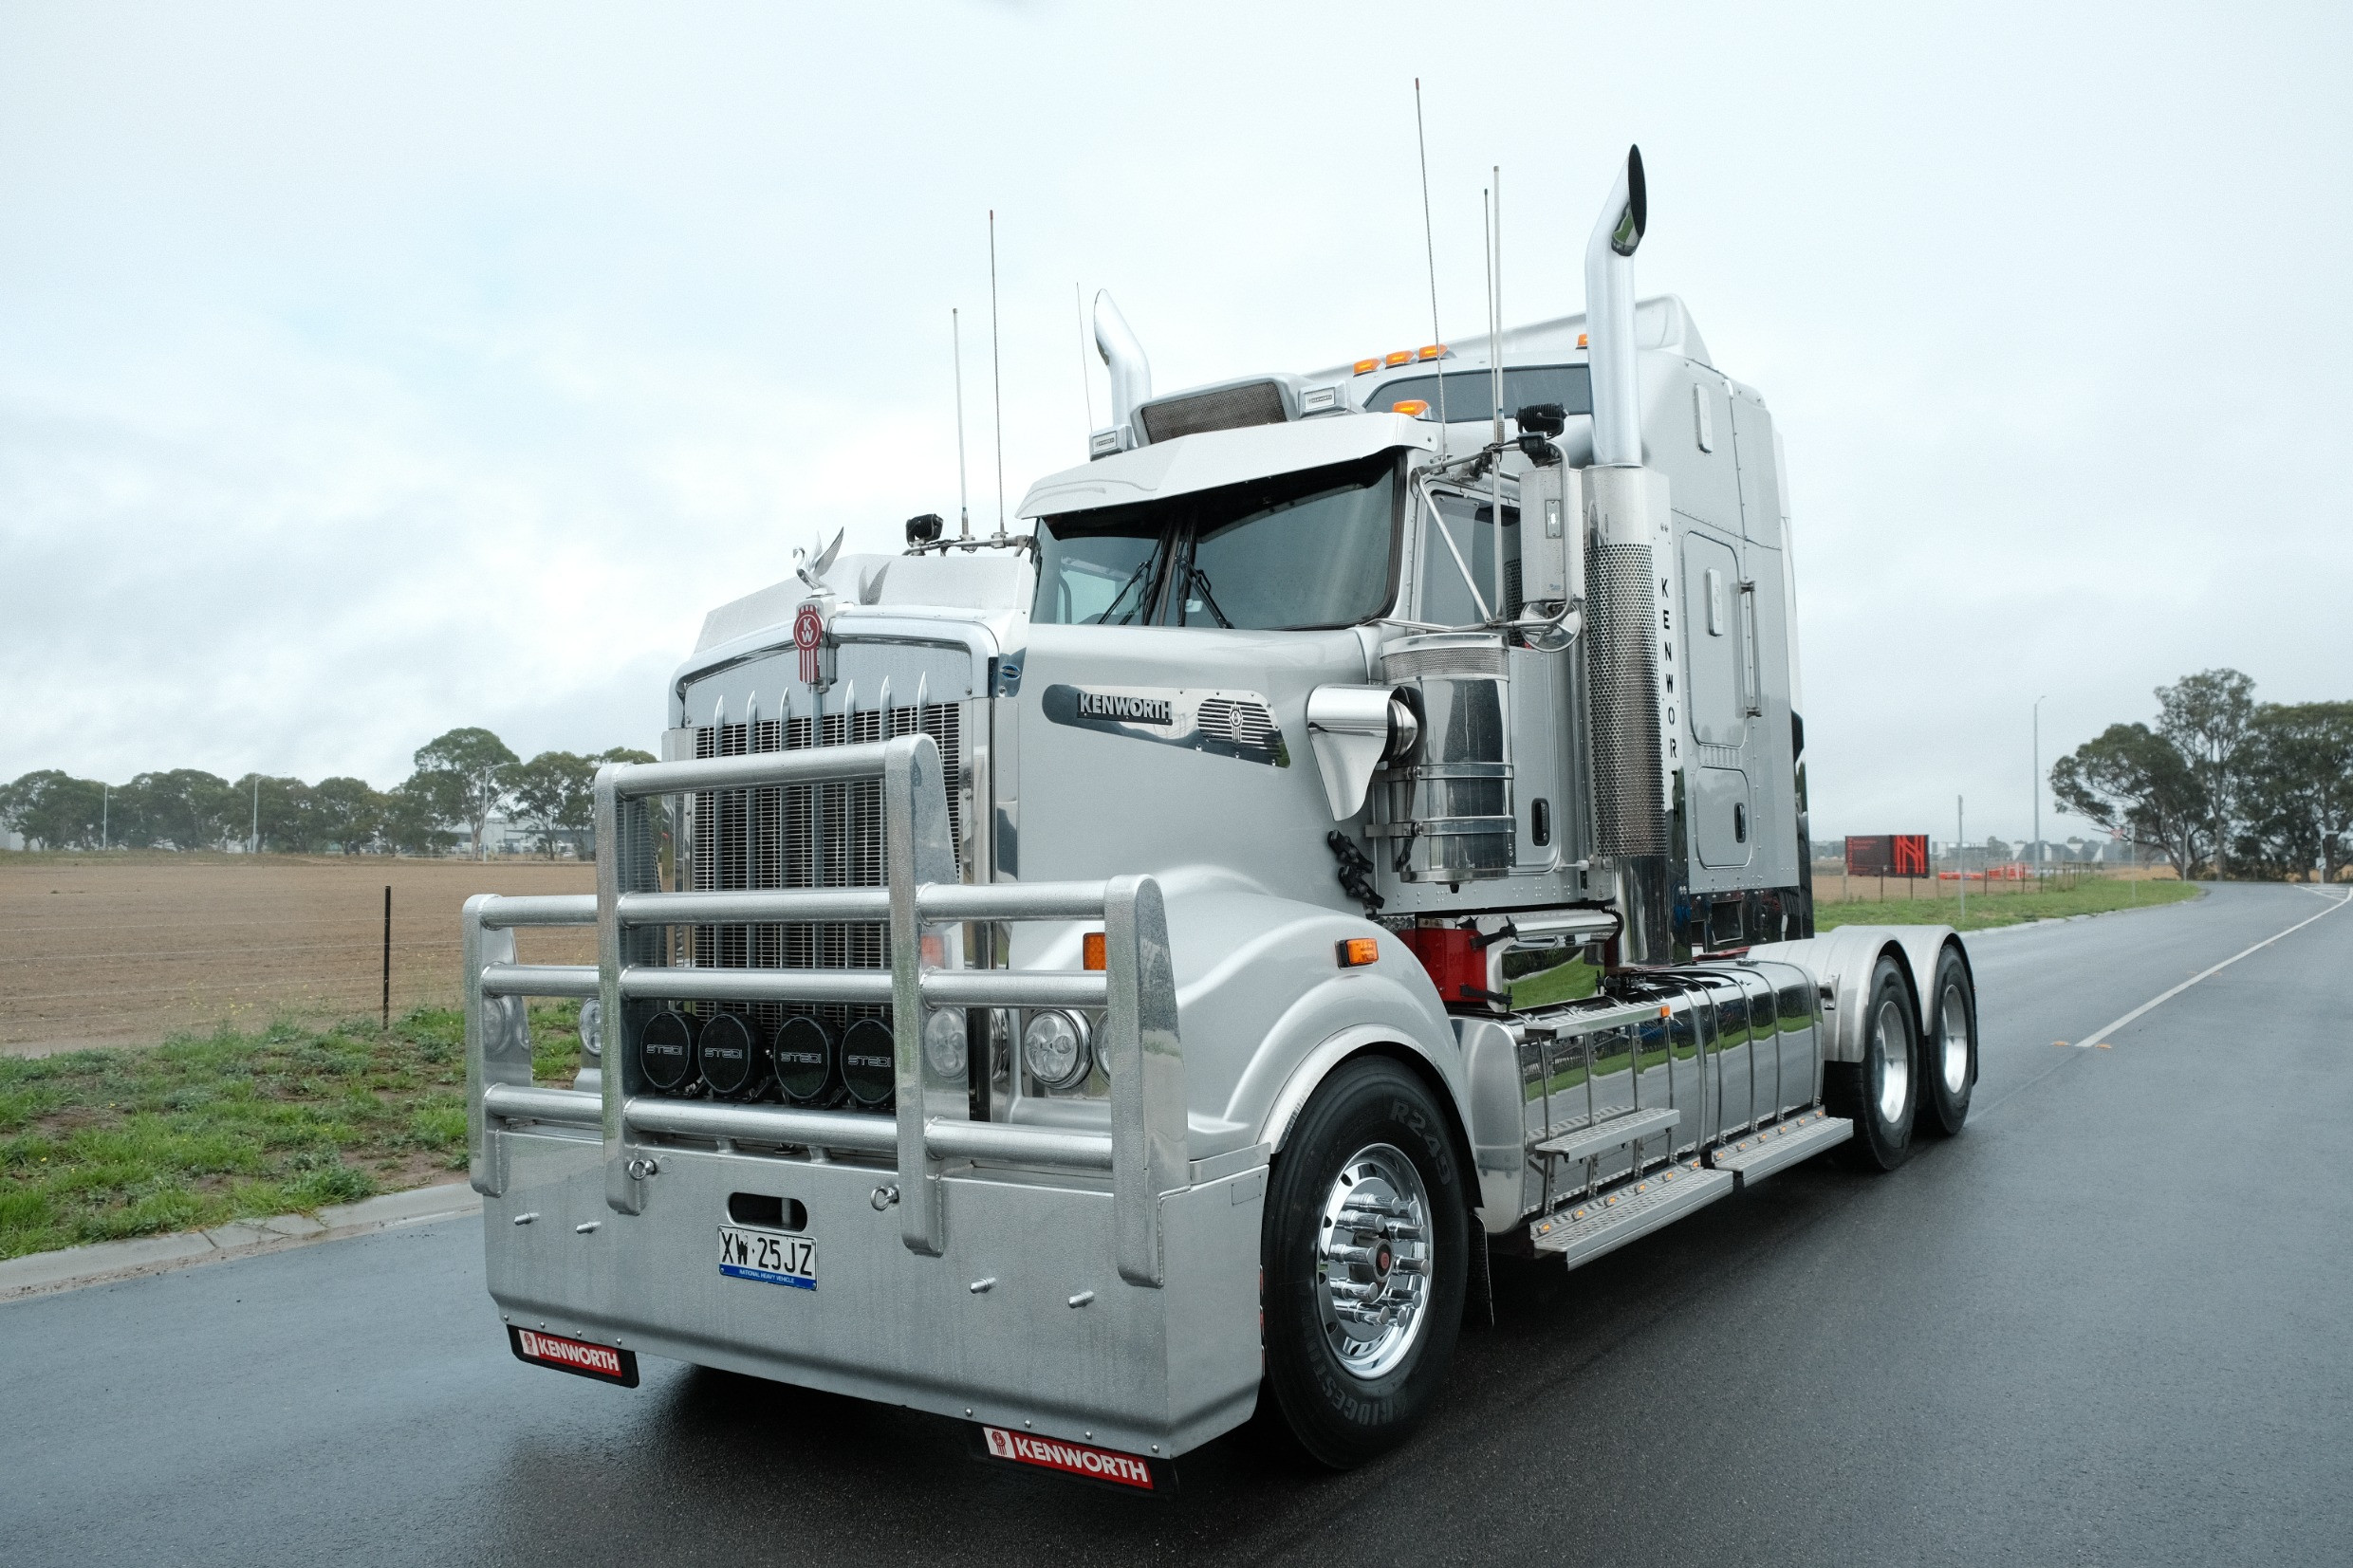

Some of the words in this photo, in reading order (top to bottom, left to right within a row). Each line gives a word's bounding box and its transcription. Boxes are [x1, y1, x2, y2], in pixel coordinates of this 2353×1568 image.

[1080, 693, 1173, 720] KENWORTH
[646, 1043, 683, 1056] STEDI
[704, 1047, 743, 1060] STEDI
[780, 1051, 822, 1064] STEDI
[847, 1054, 891, 1068] STEDI
[739, 1268, 761, 1278] NATIONAL
[760, 1272, 776, 1281] HEAVY
[776, 1275, 795, 1284] VEHICLE
[537, 1337, 620, 1372] KENWORTH
[1014, 1436, 1148, 1483] KENWORTH
